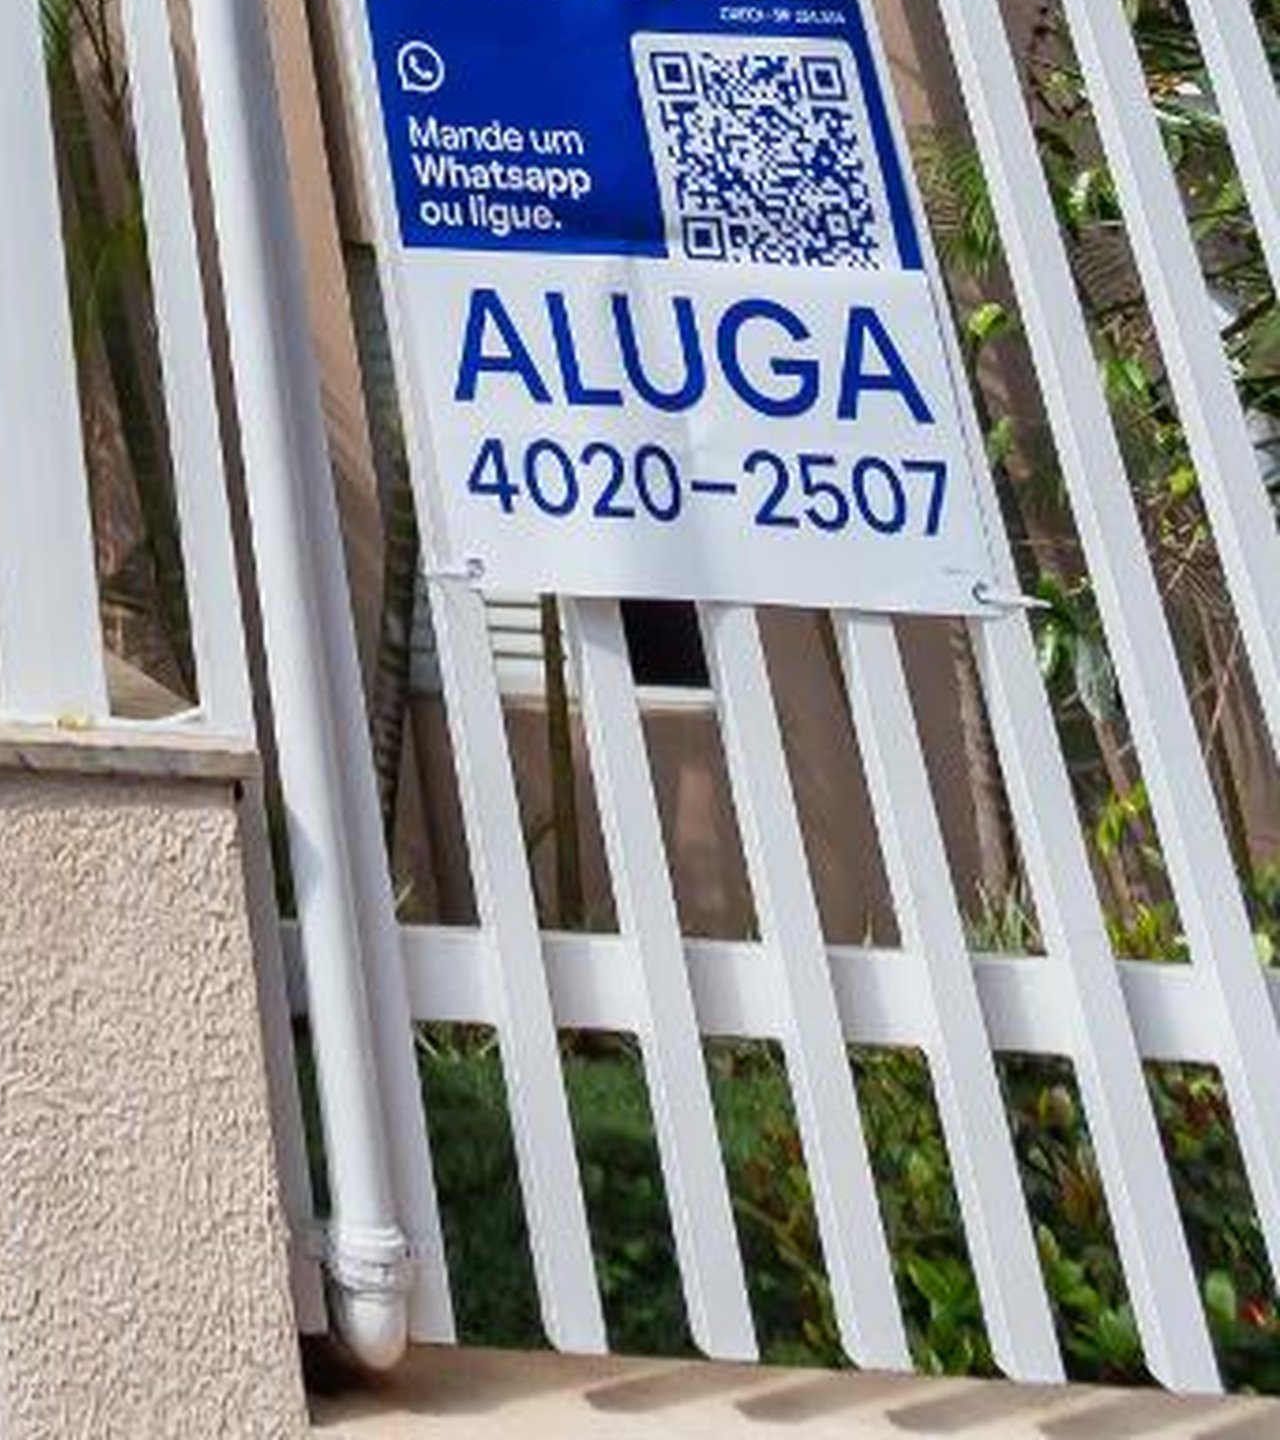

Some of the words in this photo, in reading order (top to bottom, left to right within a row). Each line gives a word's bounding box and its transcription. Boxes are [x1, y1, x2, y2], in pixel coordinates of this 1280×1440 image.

[407, 115, 523, 152] Mande
[529, 130, 585, 155] um
[411, 154, 591, 200] Whatsapp
[420, 199, 463, 226] ou
[469, 194, 563, 237] ligue.
[454, 288, 936, 425] ALUGA
[467, 438, 948, 537] 4020-2507
